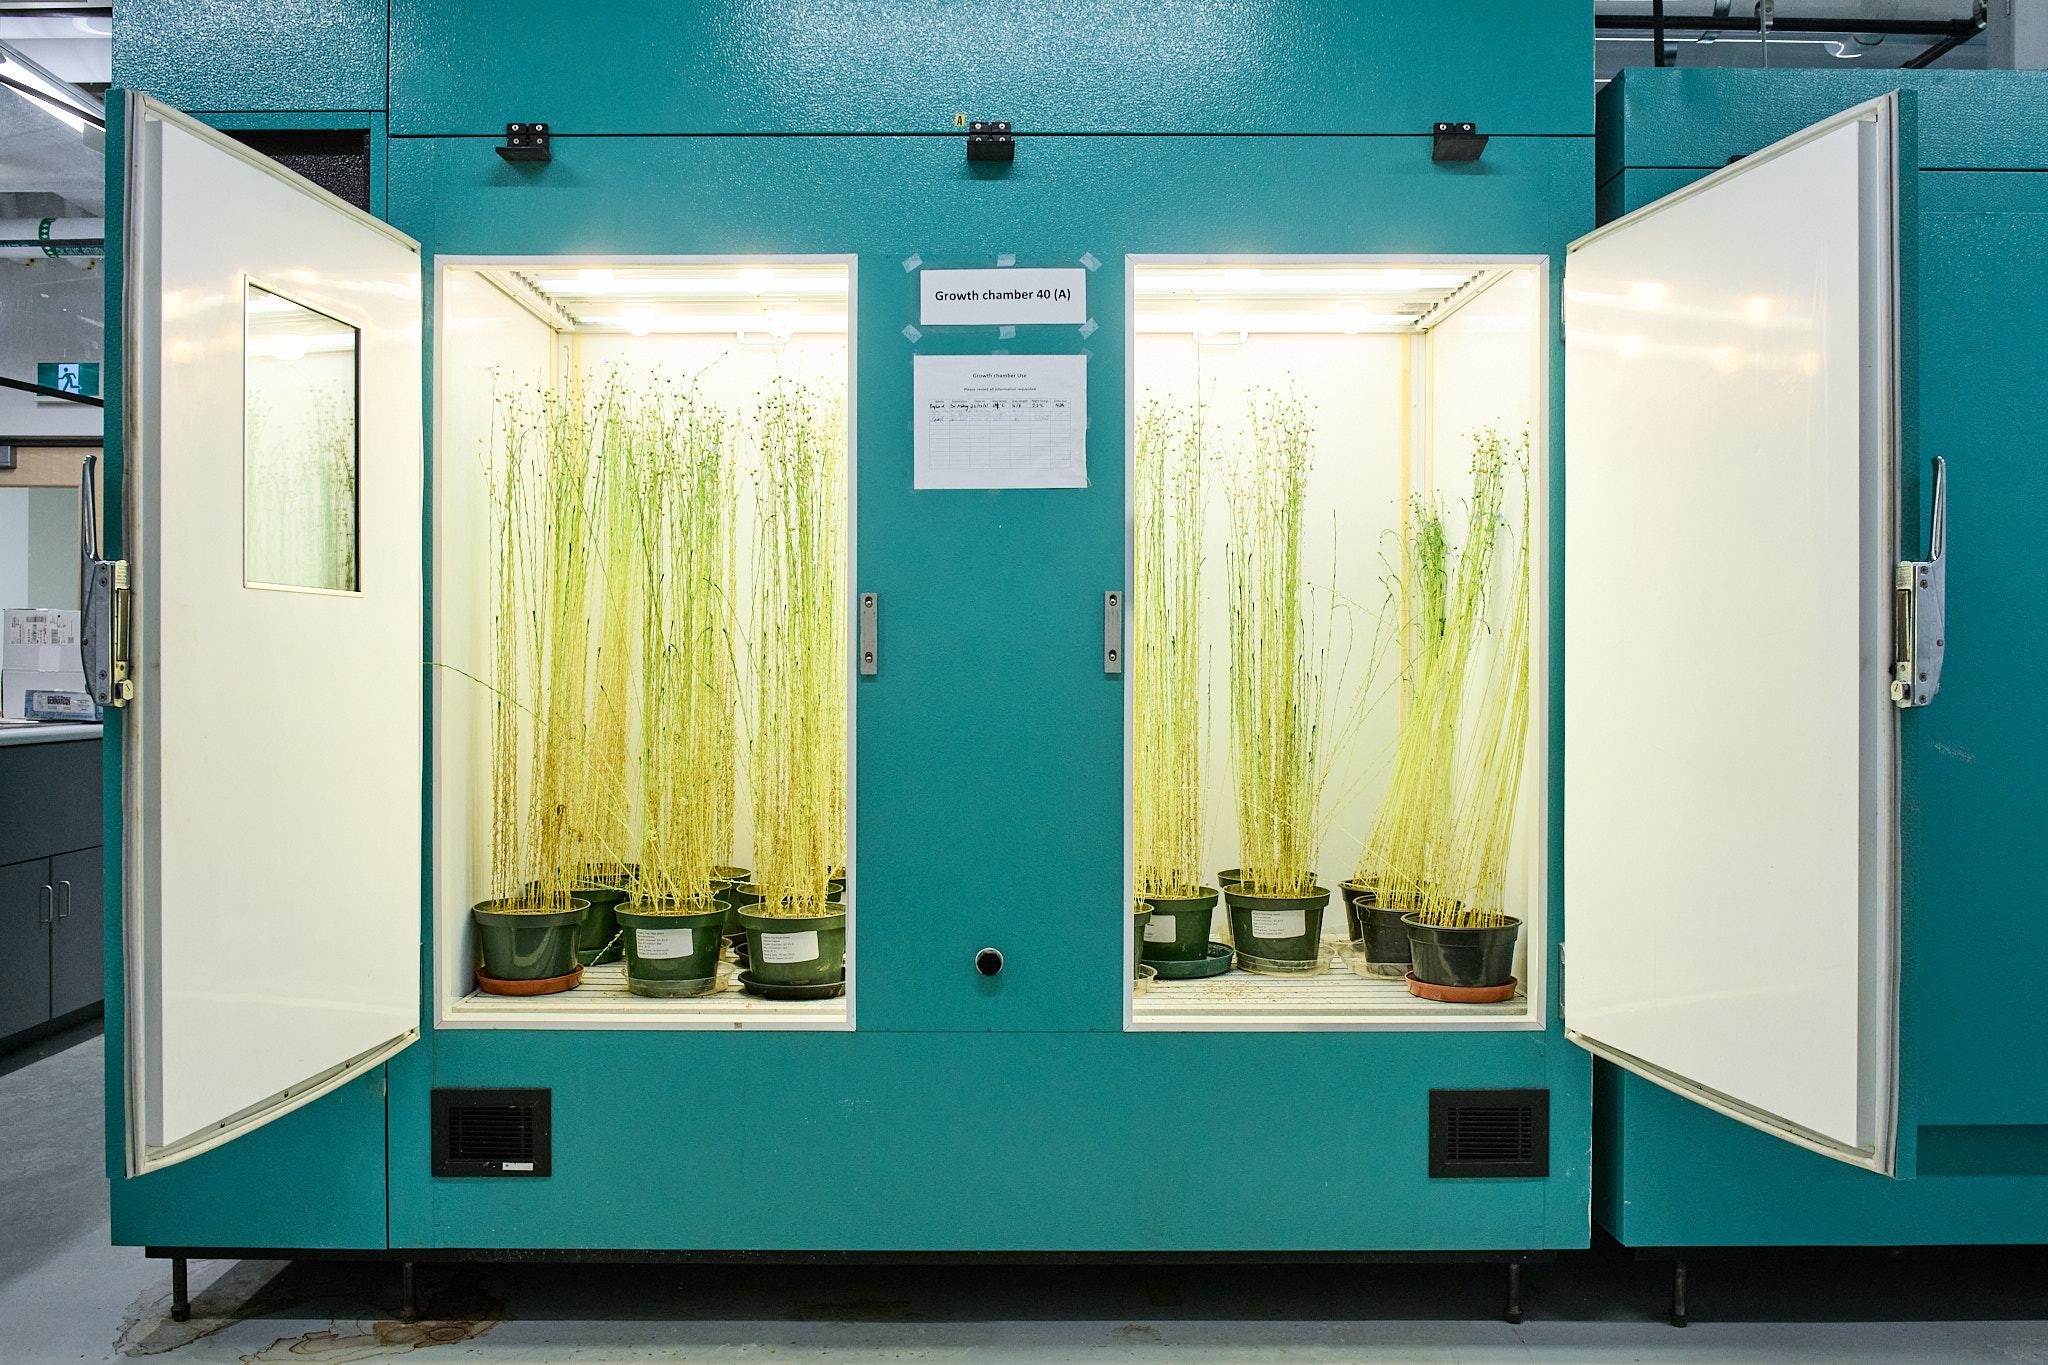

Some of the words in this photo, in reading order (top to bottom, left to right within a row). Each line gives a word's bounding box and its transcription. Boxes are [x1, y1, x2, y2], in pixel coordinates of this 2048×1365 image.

[956, 115, 963, 126] A
[935, 290, 979, 301] Growth
[982, 289, 1034, 300] chamber
[1036, 289, 1051, 299] 40
[1054, 288, 1071, 301] (A)
